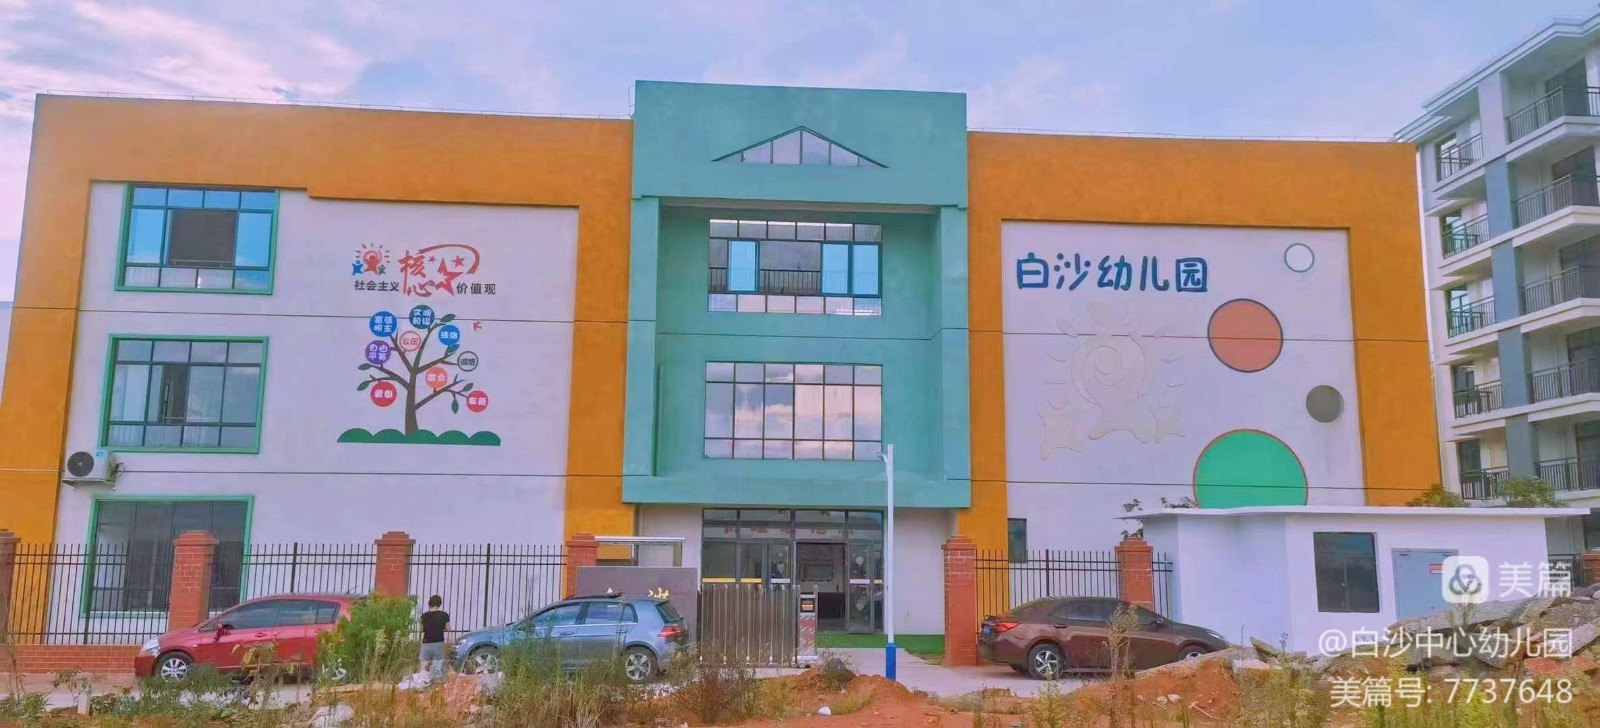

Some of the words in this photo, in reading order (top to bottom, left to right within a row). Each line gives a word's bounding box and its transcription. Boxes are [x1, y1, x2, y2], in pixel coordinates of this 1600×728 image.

[1016, 252, 1208, 293] 白沙幼儿园
[354, 280, 400, 292] 社会主义
[456, 283, 496, 295] 价值观
